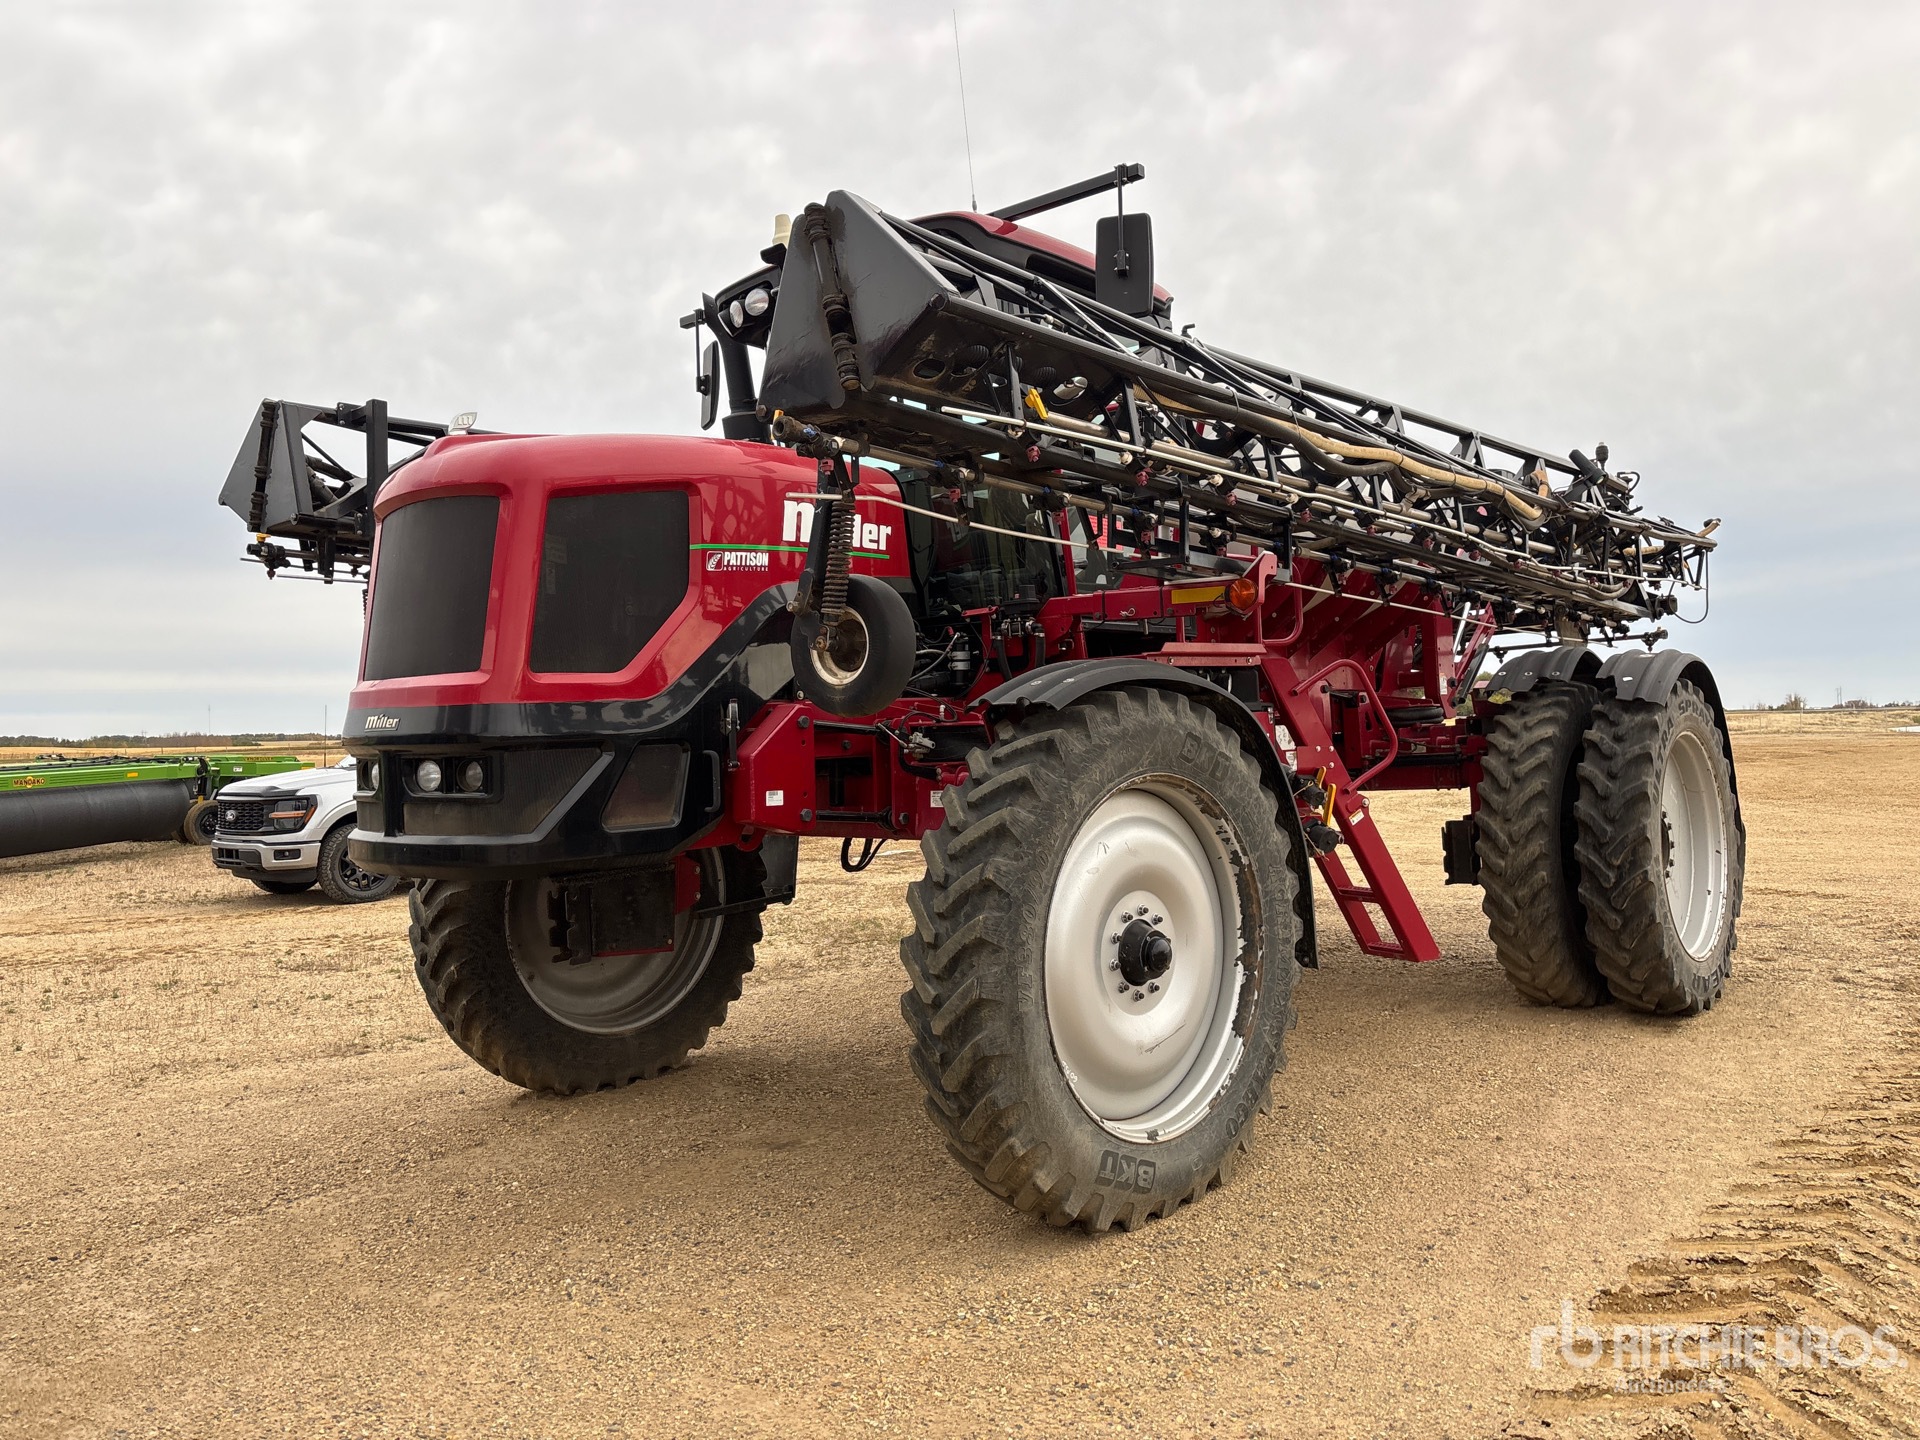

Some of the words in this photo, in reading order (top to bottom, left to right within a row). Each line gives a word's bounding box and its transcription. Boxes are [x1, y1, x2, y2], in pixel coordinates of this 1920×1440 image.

[723, 551, 769, 567] PATTISON
[1678, 699, 1711, 727] SPRAY
[1179, 733, 1232, 781] BKT
[13, 777, 45, 787] MANDAKO
[1097, 1151, 1156, 1193] BKT
